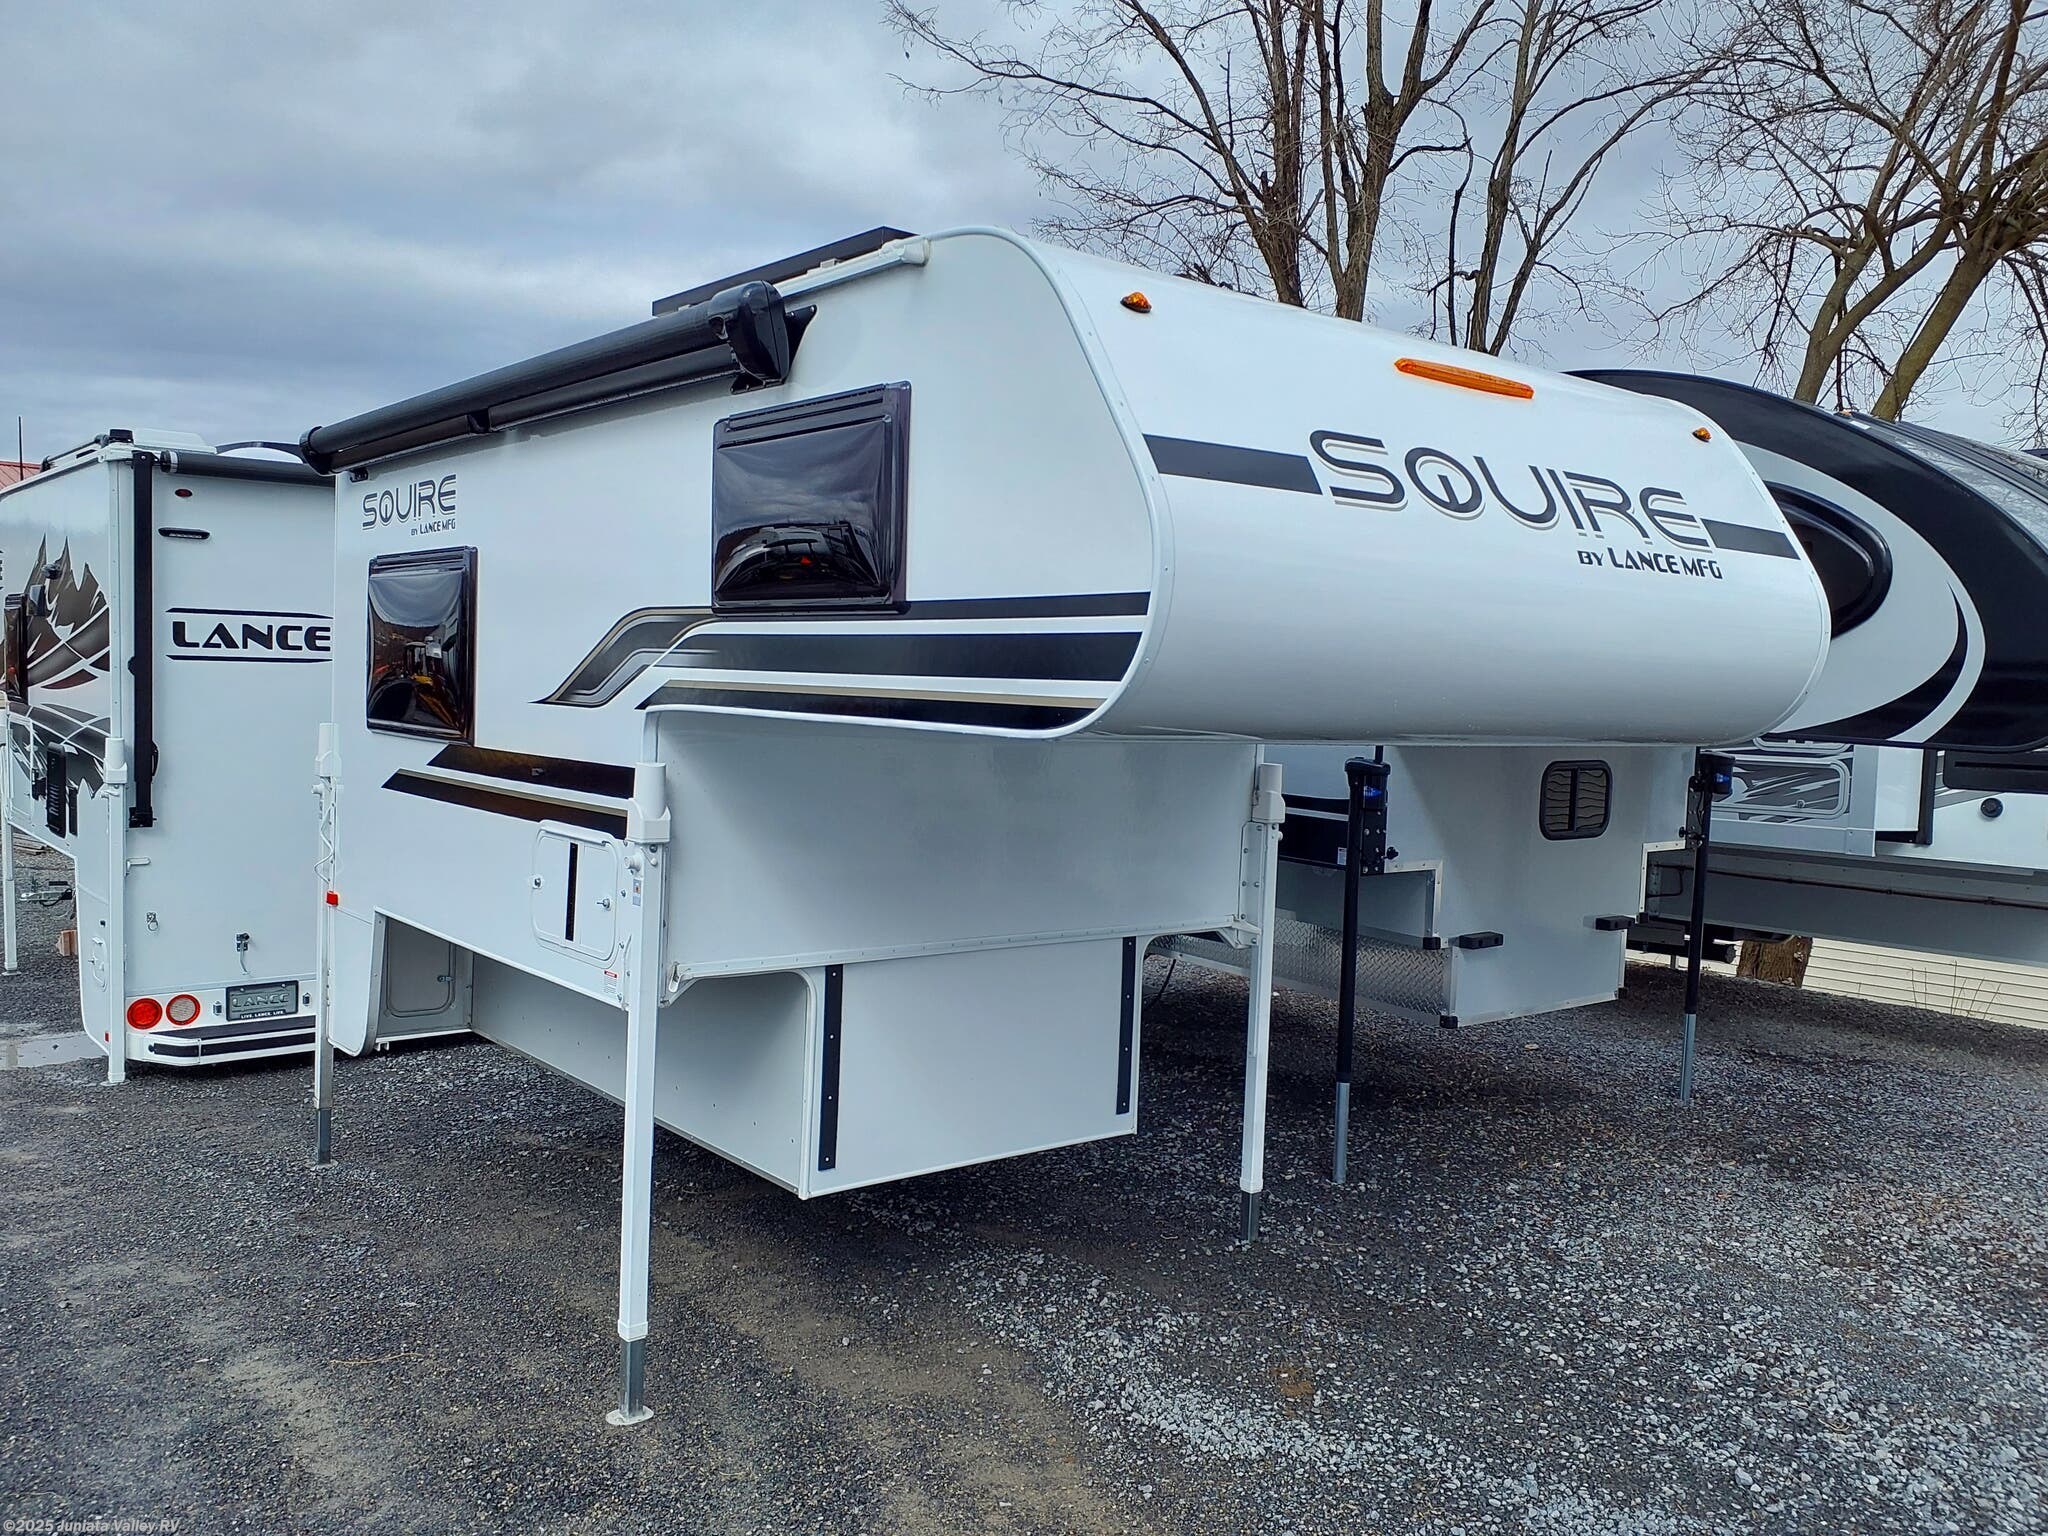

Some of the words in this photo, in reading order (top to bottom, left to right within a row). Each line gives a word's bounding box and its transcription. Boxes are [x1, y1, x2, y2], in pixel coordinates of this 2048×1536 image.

[362, 474, 457, 530] SQUIRE
[1309, 429, 1713, 553] SQUIRE
[419, 521, 441, 535] LANCE
[441, 518, 456, 532] MFG
[1577, 550, 1604, 567] BY
[1607, 547, 1680, 575] LANCE
[1680, 556, 1723, 580] MFG
[172, 621, 331, 652] LANCE
[232, 993, 290, 1008] LANCE
